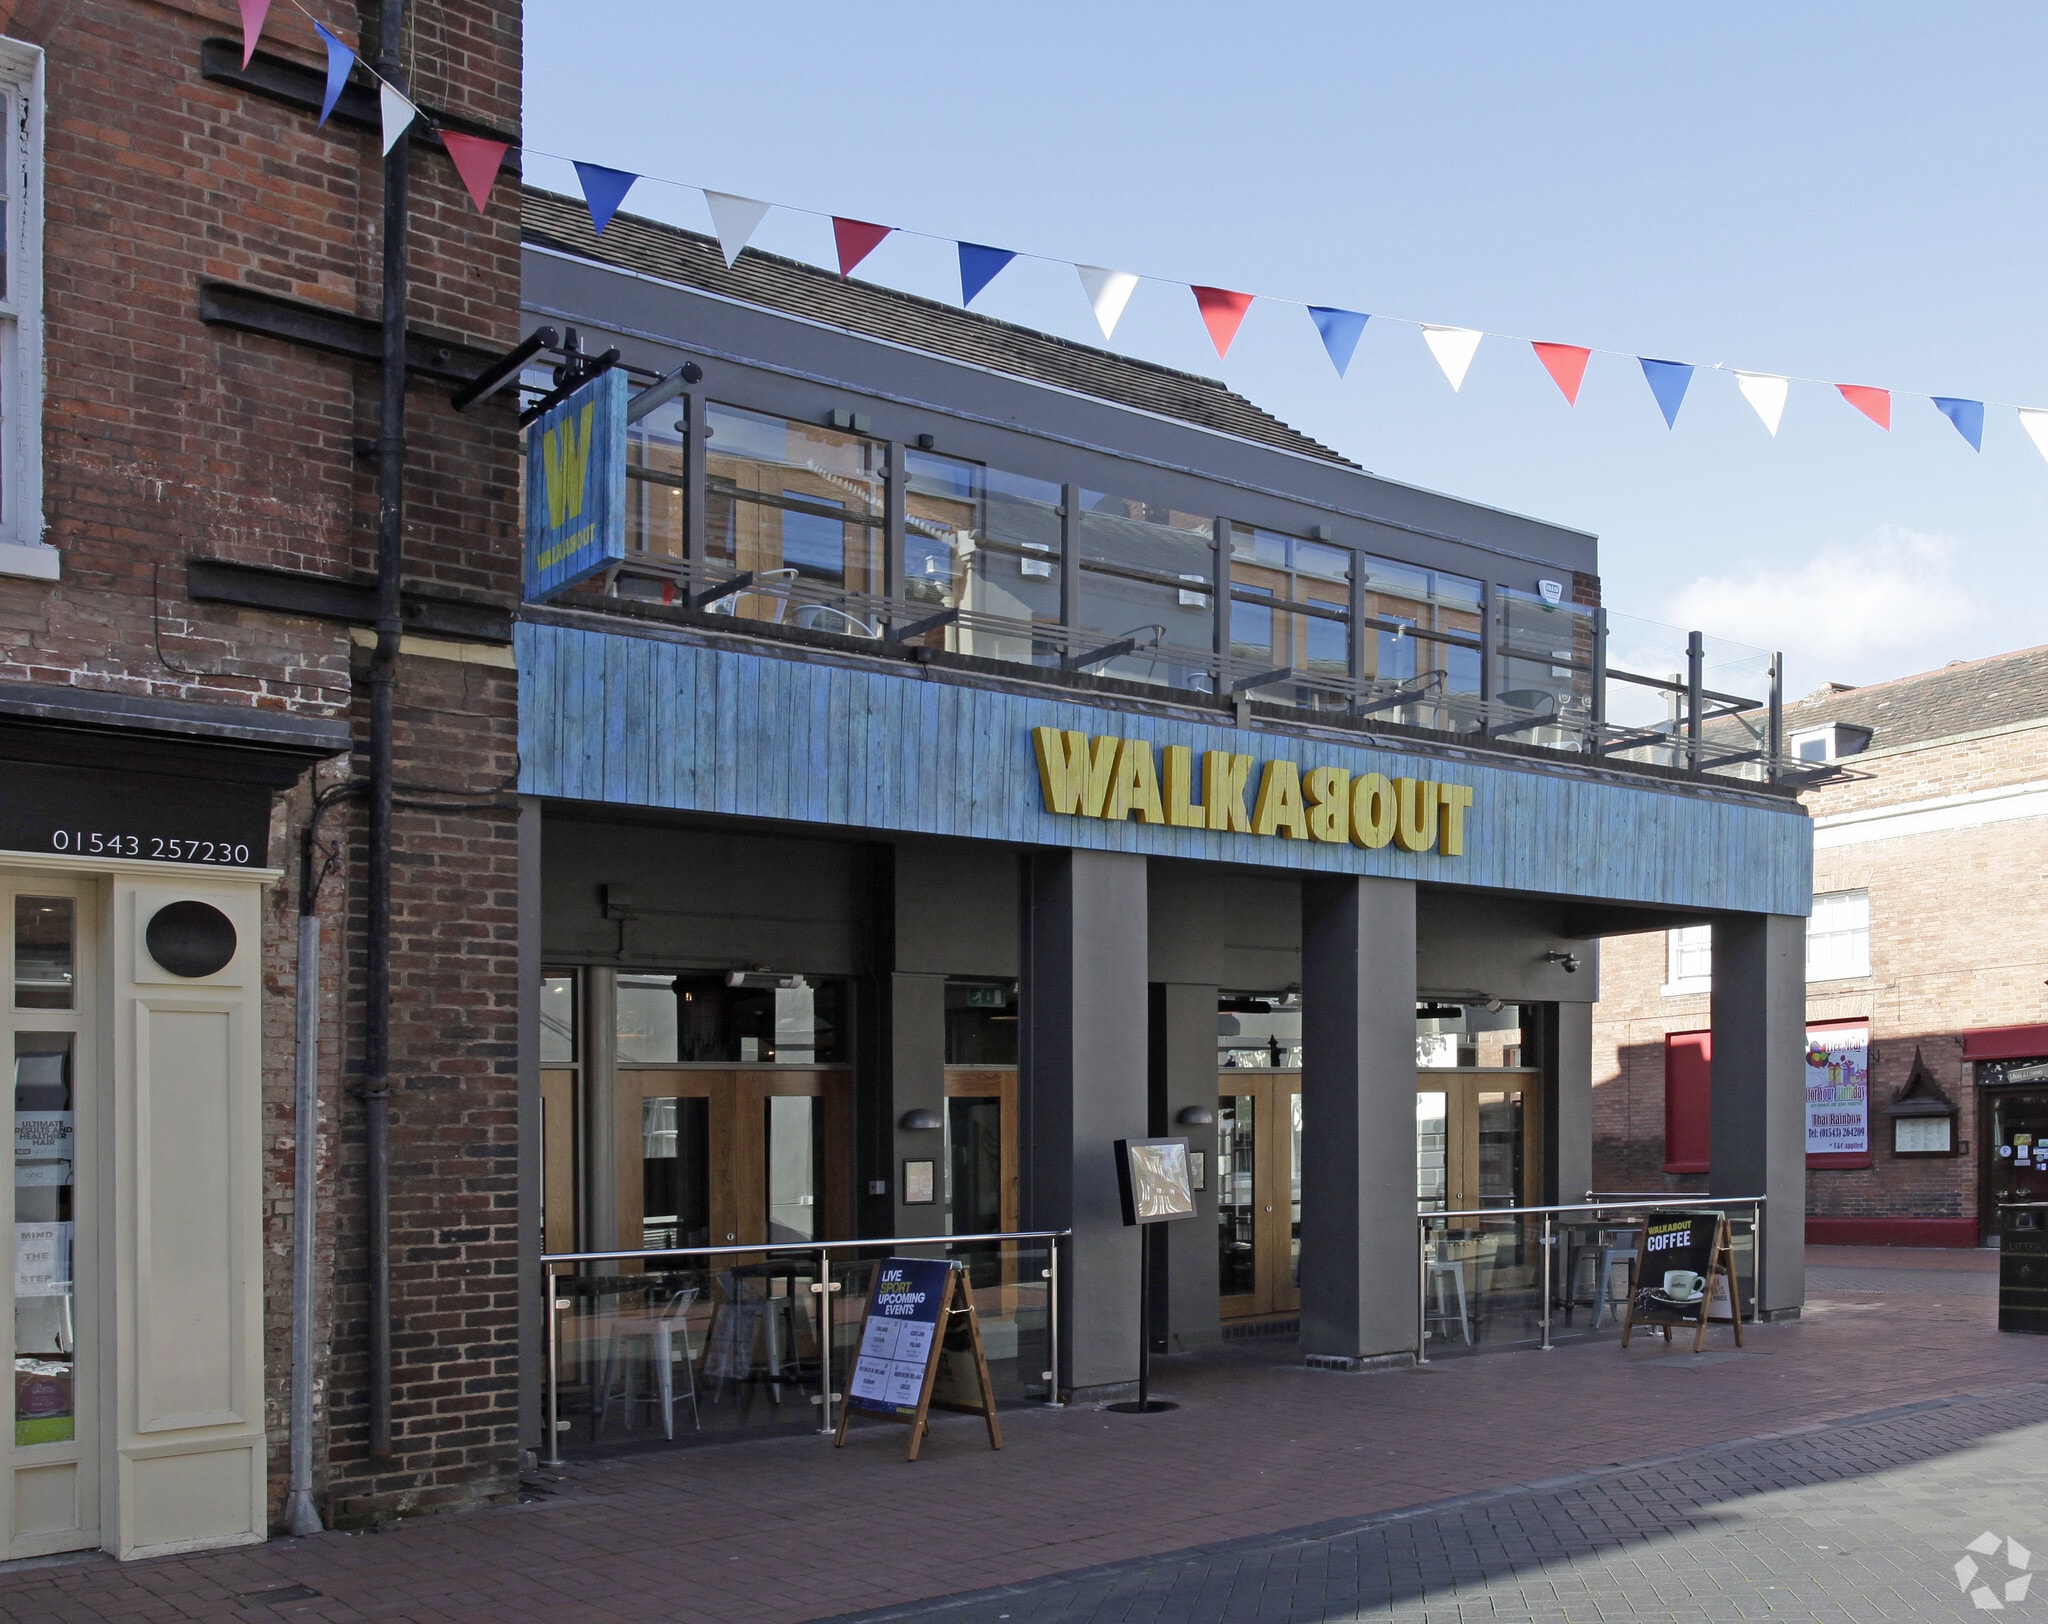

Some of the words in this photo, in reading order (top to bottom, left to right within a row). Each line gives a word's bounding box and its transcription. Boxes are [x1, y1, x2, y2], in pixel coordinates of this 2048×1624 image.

[543, 400, 595, 530] W
[537, 522, 596, 573] WALKABOUT
[1031, 726, 1474, 857] WALKABOUT
[53, 830, 139, 856] 01543
[151, 838, 249, 864] 257230
[1808, 1087, 1817, 1101] for
[22, 1120, 64, 1128] ULTIMATE
[1813, 1114, 1828, 1126] Thai
[1830, 1113, 1862, 1125] Rainbow
[15, 1127, 50, 1135] RESULTS
[53, 1126, 73, 1134] AND
[1647, 1220, 1693, 1236] WALKABOUT
[21, 1231, 54, 1240] MIND
[1647, 1230, 1691, 1252] COFFEE
[24, 1252, 49, 1260] THE
[20, 1274, 52, 1283] STEP
[882, 1269, 903, 1282] LIVE
[880, 1281, 913, 1294] SPORT
[878, 1292, 926, 1305] UPCOMING
[885, 1304, 915, 1316] EVENTS
